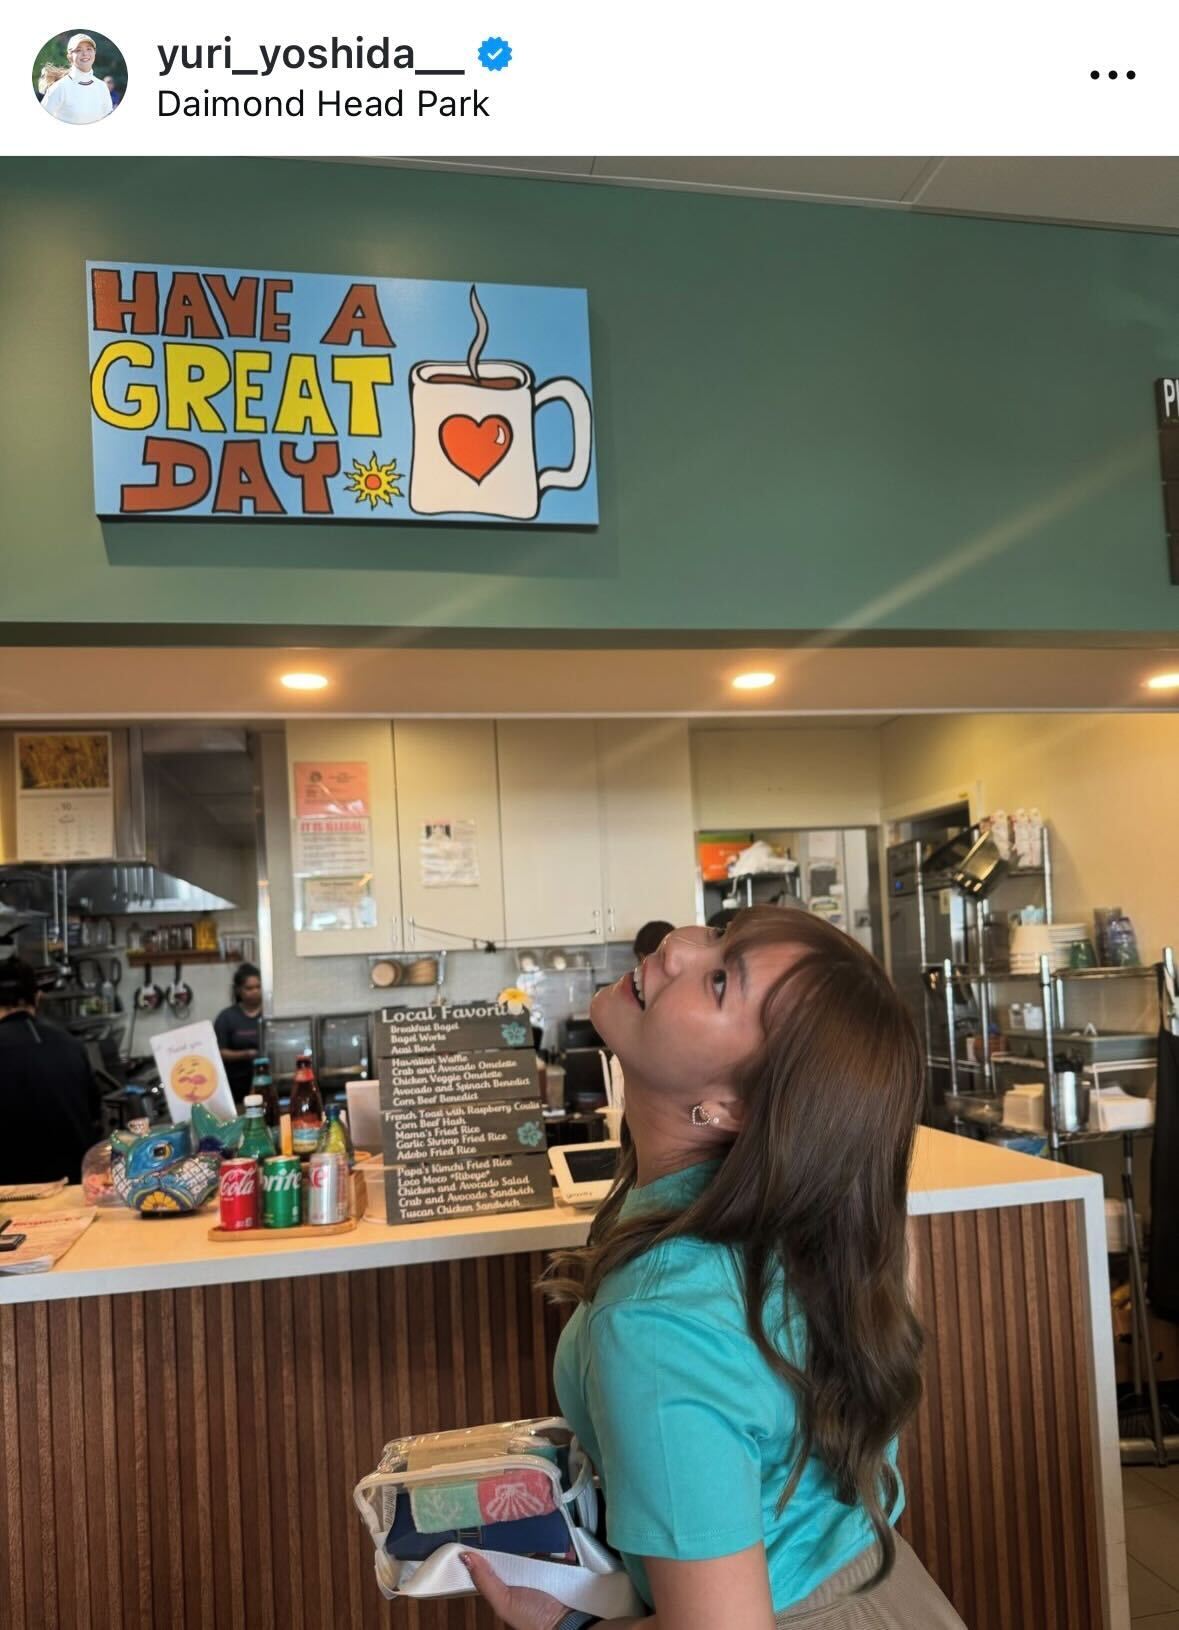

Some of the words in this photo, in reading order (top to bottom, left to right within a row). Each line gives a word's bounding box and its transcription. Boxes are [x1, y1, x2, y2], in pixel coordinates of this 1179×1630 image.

[91, 268, 293, 342] HAVE
[320, 284, 397, 348] A
[90, 340, 393, 437] GREAT
[120, 437, 340, 514] DAY
[382, 1007, 436, 1023] Local
[433, 1022, 459, 1033] Bagel
[390, 1034, 418, 1044] Bagel
[391, 1058, 436, 1067] Hawaiian
[437, 1055, 468, 1064] Waffle
[391, 1066, 414, 1076] Crab
[416, 1064, 435, 1074] and
[437, 1063, 476, 1073] Avocado
[478, 1059, 517, 1069] Omelette
[392, 1076, 428, 1086] Chicken
[429, 1073, 461, 1084] Veggie
[463, 1070, 503, 1080] Omelette
[392, 1085, 432, 1096] Avocado
[434, 1082, 454, 1093] and
[455, 1080, 491, 1092] Spinach
[492, 1078, 530, 1088] Benedict
[392, 1097, 416, 1107] Corn
[417, 1095, 437, 1105] Beef
[439, 1092, 478, 1103] Benedict
[385, 1111, 417, 1122] French
[418, 1109, 444, 1118] Toast
[466, 1104, 512, 1115] Raspberry
[395, 1121, 417, 1130] Corn
[419, 1118, 440, 1128] Beef
[442, 1117, 466, 1127] Hash
[395, 1129, 432, 1140] Mama's
[434, 1127, 458, 1136] Fried
[460, 1124, 480, 1134] Rice
[395, 1139, 425, 1150] Garlic
[427, 1136, 459, 1147] Shrimp
[461, 1133, 485, 1143] Fried
[487, 1131, 507, 1141] Rice
[396, 1150, 428, 1160] Adobo
[430, 1147, 454, 1157] Fried
[456, 1145, 477, 1155] Rice
[431, 1162, 464, 1174] Kimchi
[465, 1160, 490, 1170] Fried
[492, 1158, 513, 1168] Rice
[397, 1178, 421, 1188] Loco
[422, 1175, 448, 1185] Moco
[397, 1187, 435, 1197] Chicken
[437, 1183, 456, 1193] and
[459, 1179, 499, 1190] Avocado
[501, 1175, 530, 1186] Salad
[398, 1197, 422, 1208] Crab
[424, 1194, 445, 1205] and
[447, 1191, 487, 1202] Avocado
[489, 1186, 535, 1198] Sandwich
[400, 1208, 435, 1219] Tuscan
[436, 1204, 473, 1215] Chicken
[475, 1198, 520, 1211] Sandwich
